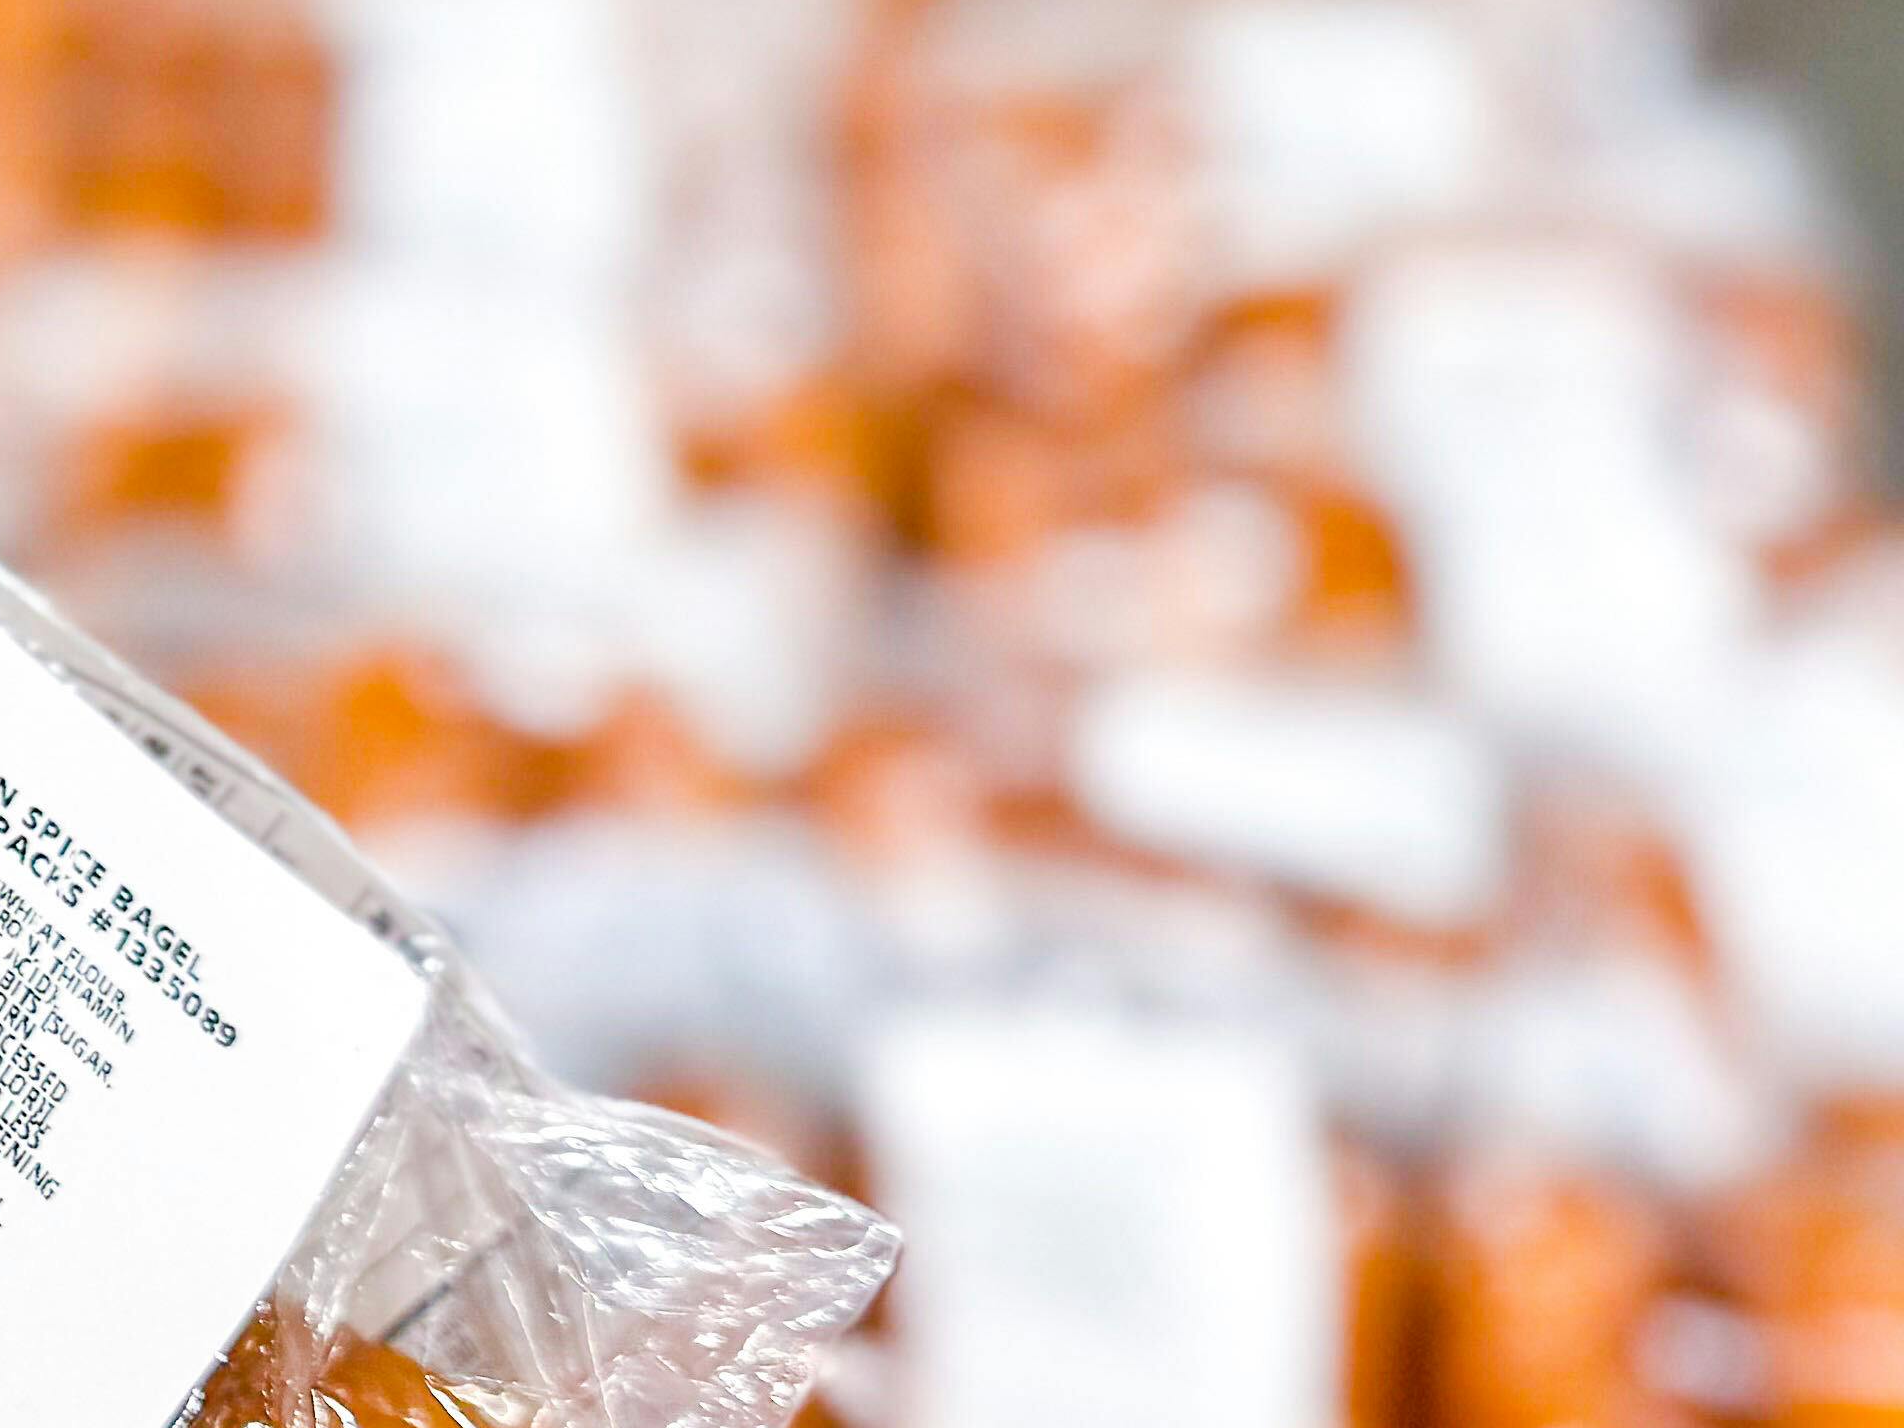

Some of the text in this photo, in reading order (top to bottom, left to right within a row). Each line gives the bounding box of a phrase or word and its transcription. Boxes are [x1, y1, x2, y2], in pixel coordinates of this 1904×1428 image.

[20, 805, 107, 889] SPICE
[110, 883, 201, 983] BAGEL
[47, 955, 135, 1044] THIAMIN
[87, 906, 238, 1048] #1335089
